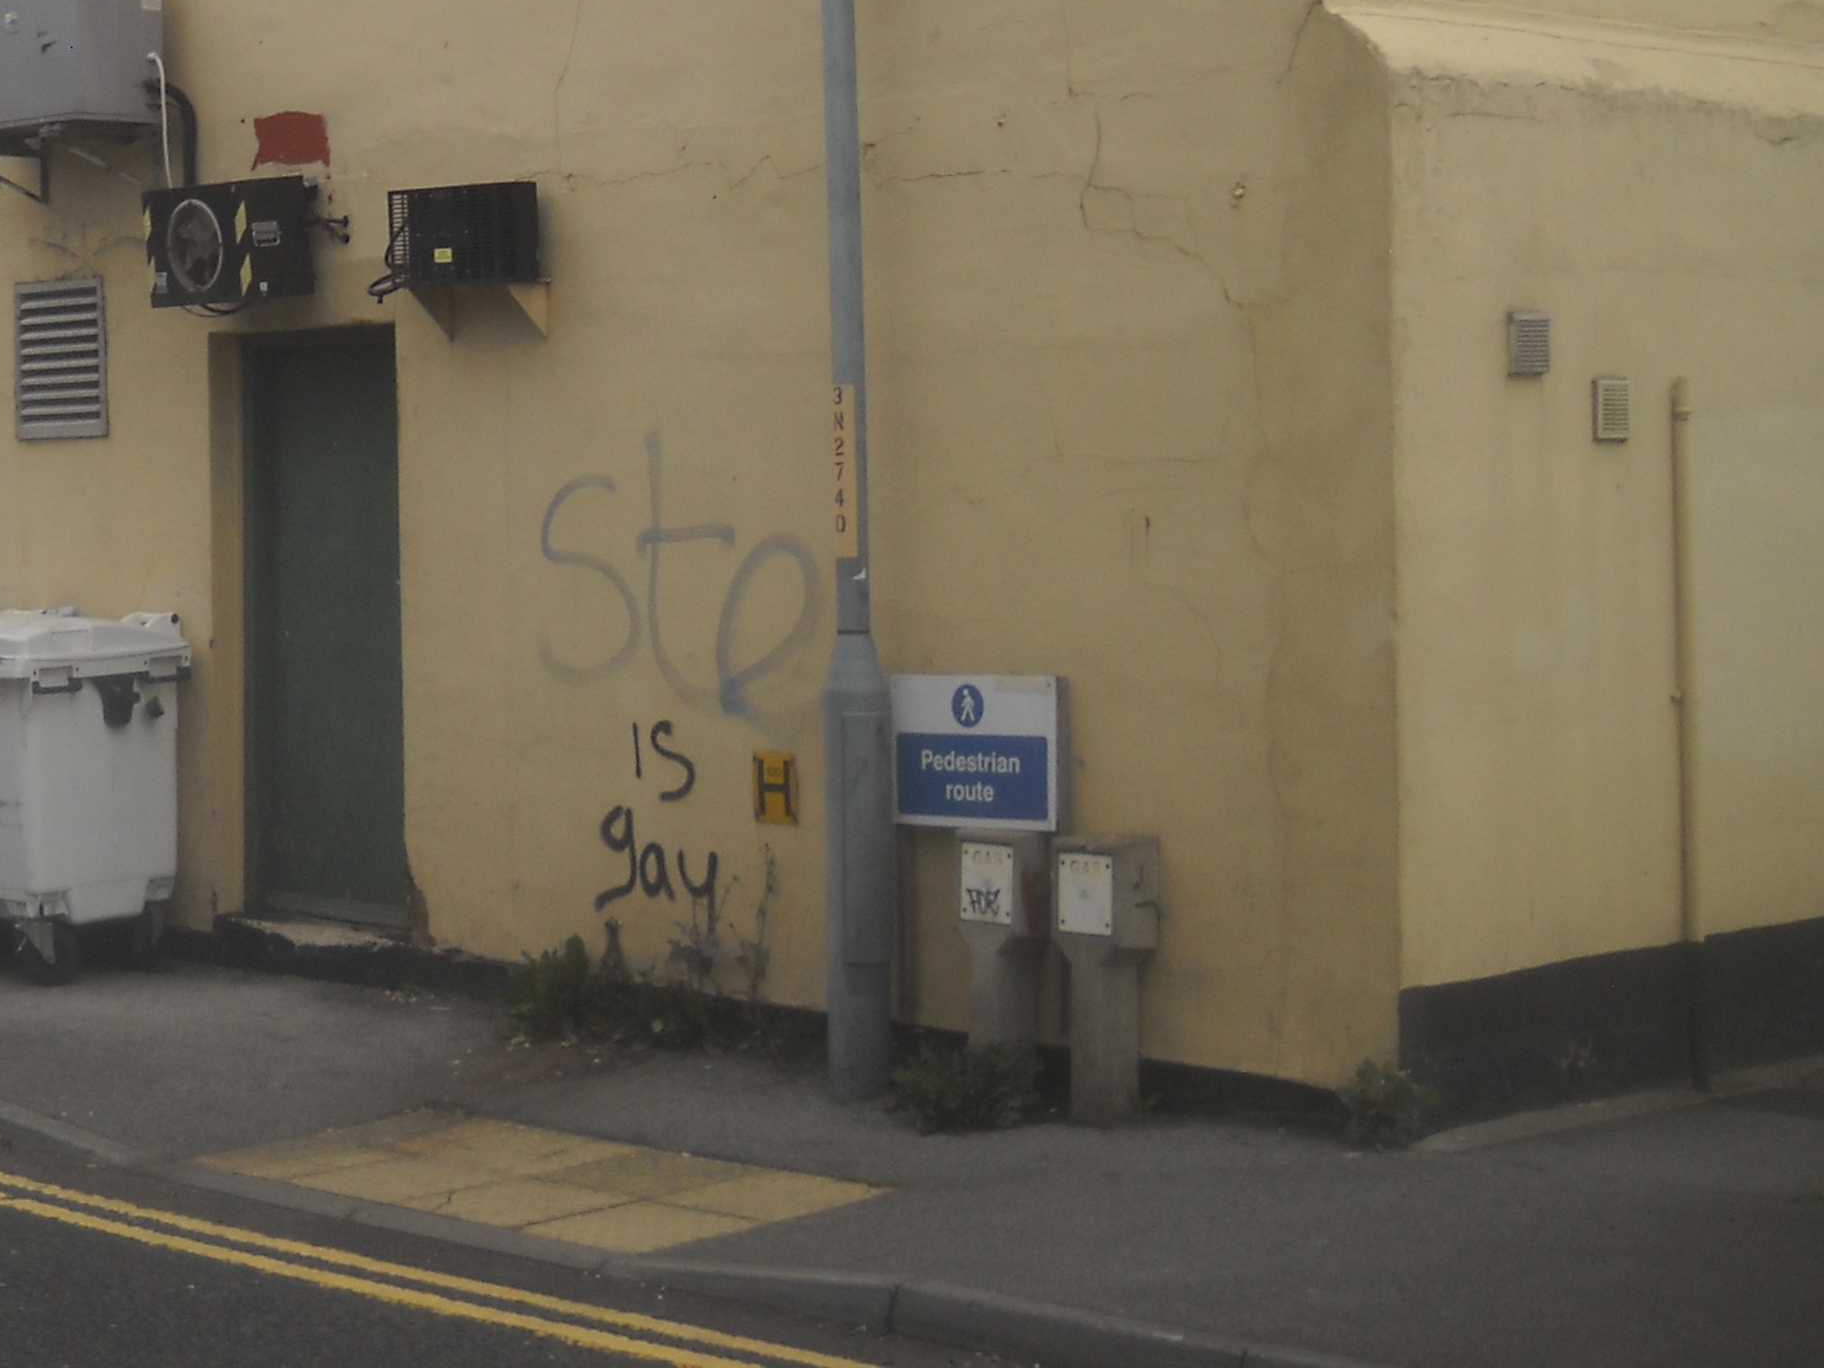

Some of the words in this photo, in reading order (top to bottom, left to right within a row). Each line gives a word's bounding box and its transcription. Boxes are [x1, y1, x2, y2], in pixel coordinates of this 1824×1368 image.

[920, 749, 1021, 775] Pedestrian
[754, 756, 798, 819] H
[945, 780, 995, 803] route
[593, 804, 720, 931] gay
